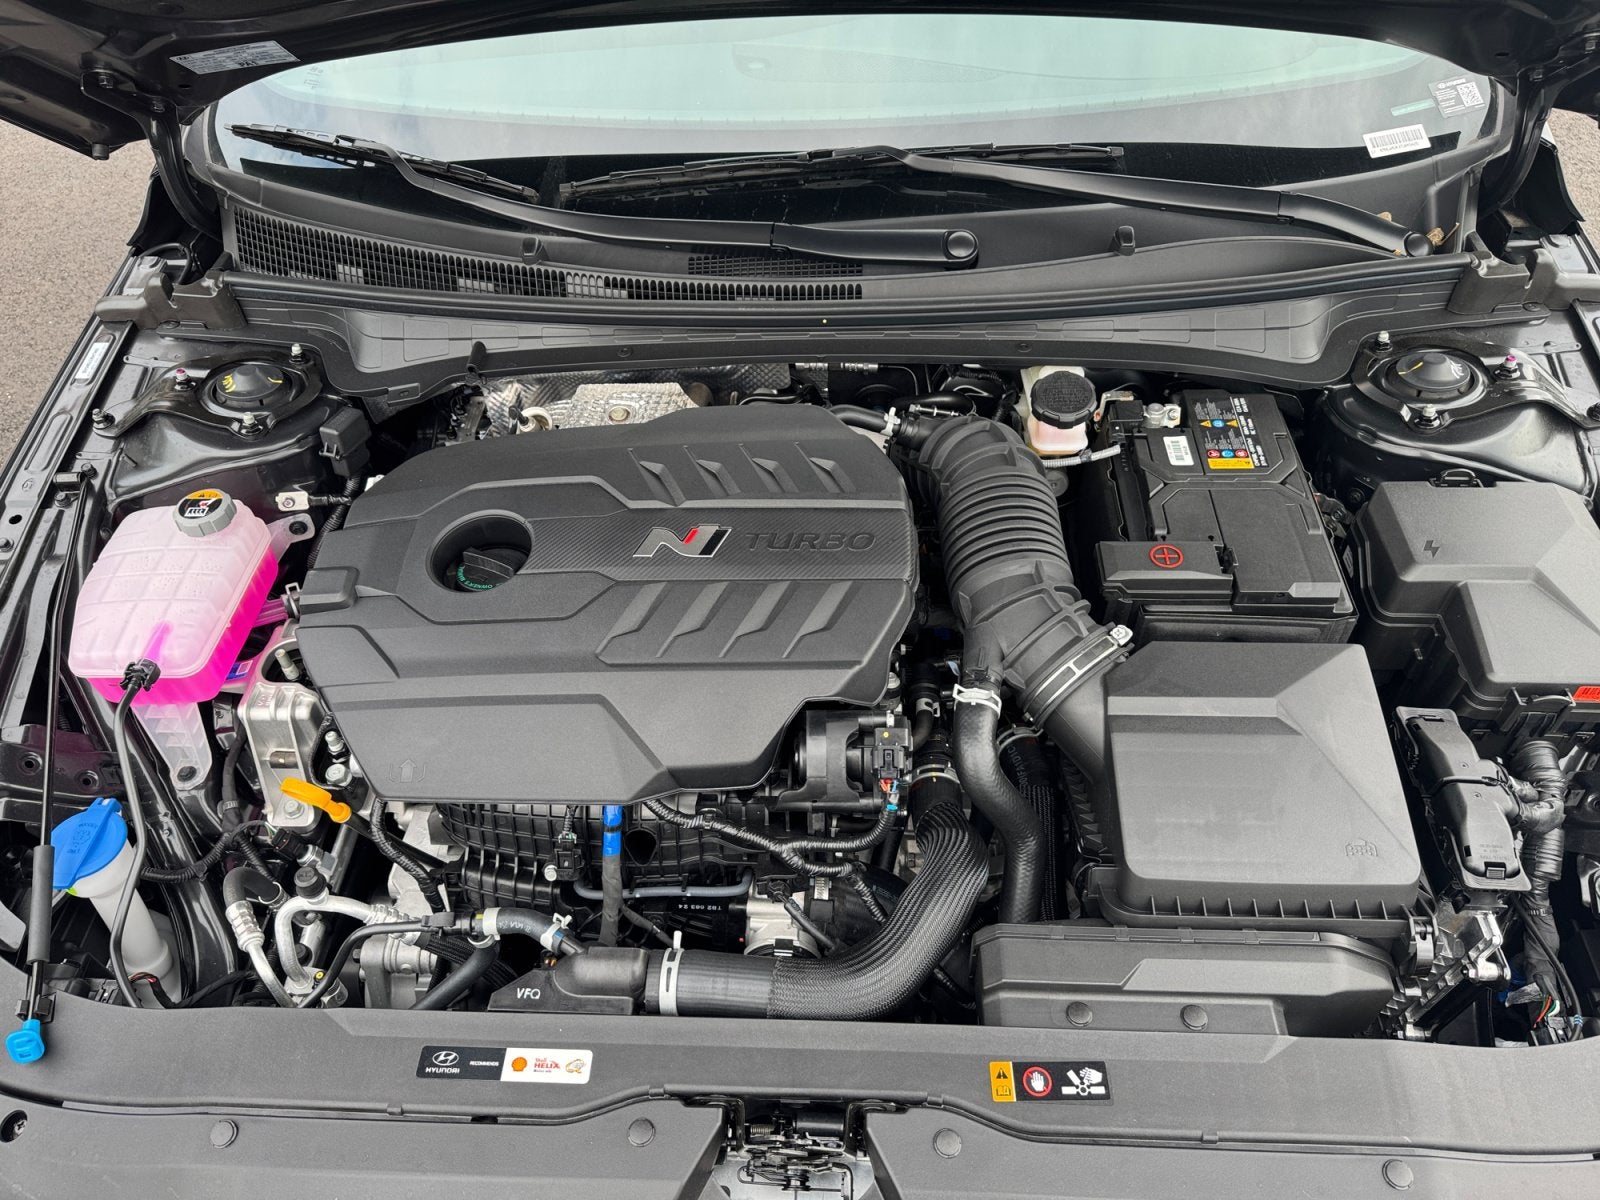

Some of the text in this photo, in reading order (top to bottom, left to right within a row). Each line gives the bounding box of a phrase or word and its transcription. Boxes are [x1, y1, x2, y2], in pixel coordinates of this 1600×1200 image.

[746, 532, 875, 551] TURBO
[517, 987, 541, 1000] VFQ
[425, 1066, 461, 1074] HYUNDAI
[534, 1061, 561, 1069] HELIX
